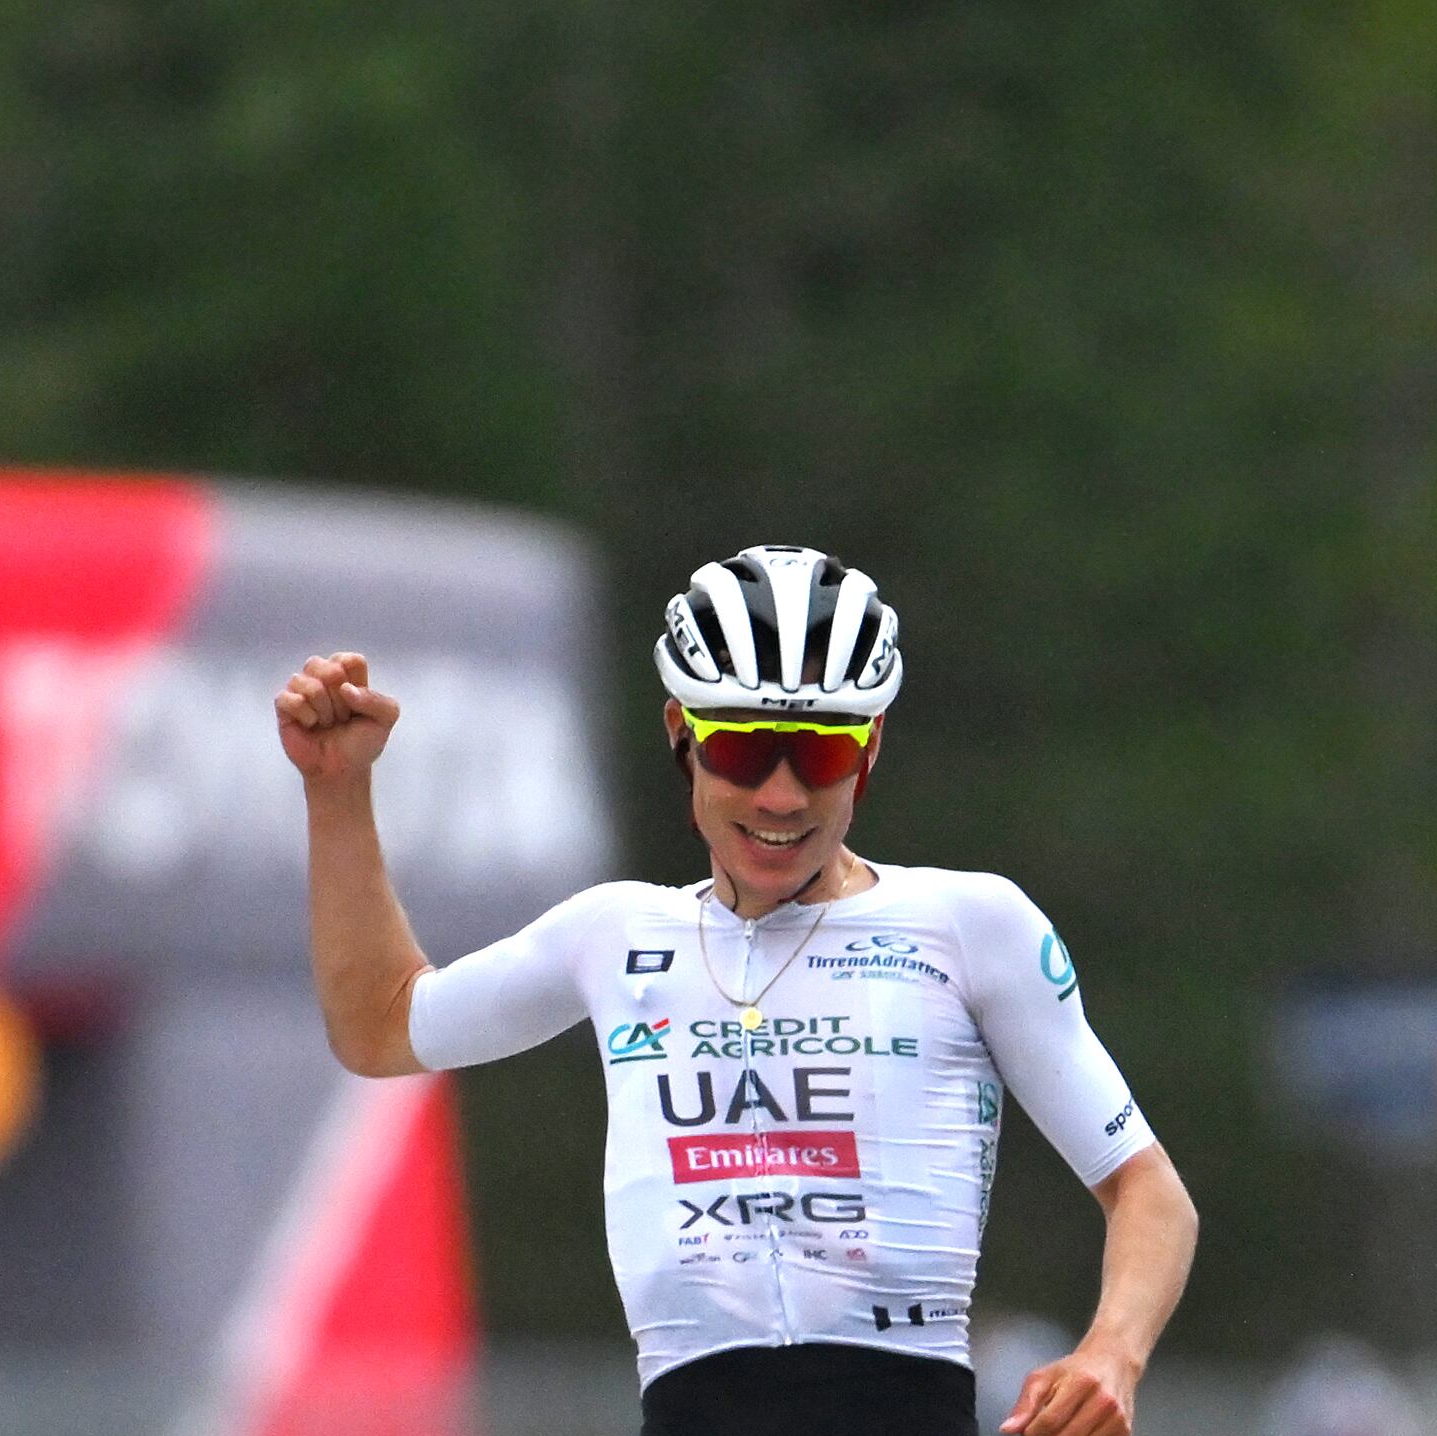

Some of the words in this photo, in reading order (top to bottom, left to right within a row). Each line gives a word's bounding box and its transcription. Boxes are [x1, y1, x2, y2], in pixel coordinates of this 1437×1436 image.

[691, 1037, 919, 1059] AGRICOLE
[657, 1067, 854, 1127] UAE
[686, 1145, 839, 1171] Emirates
[678, 1191, 866, 1230] XRG
